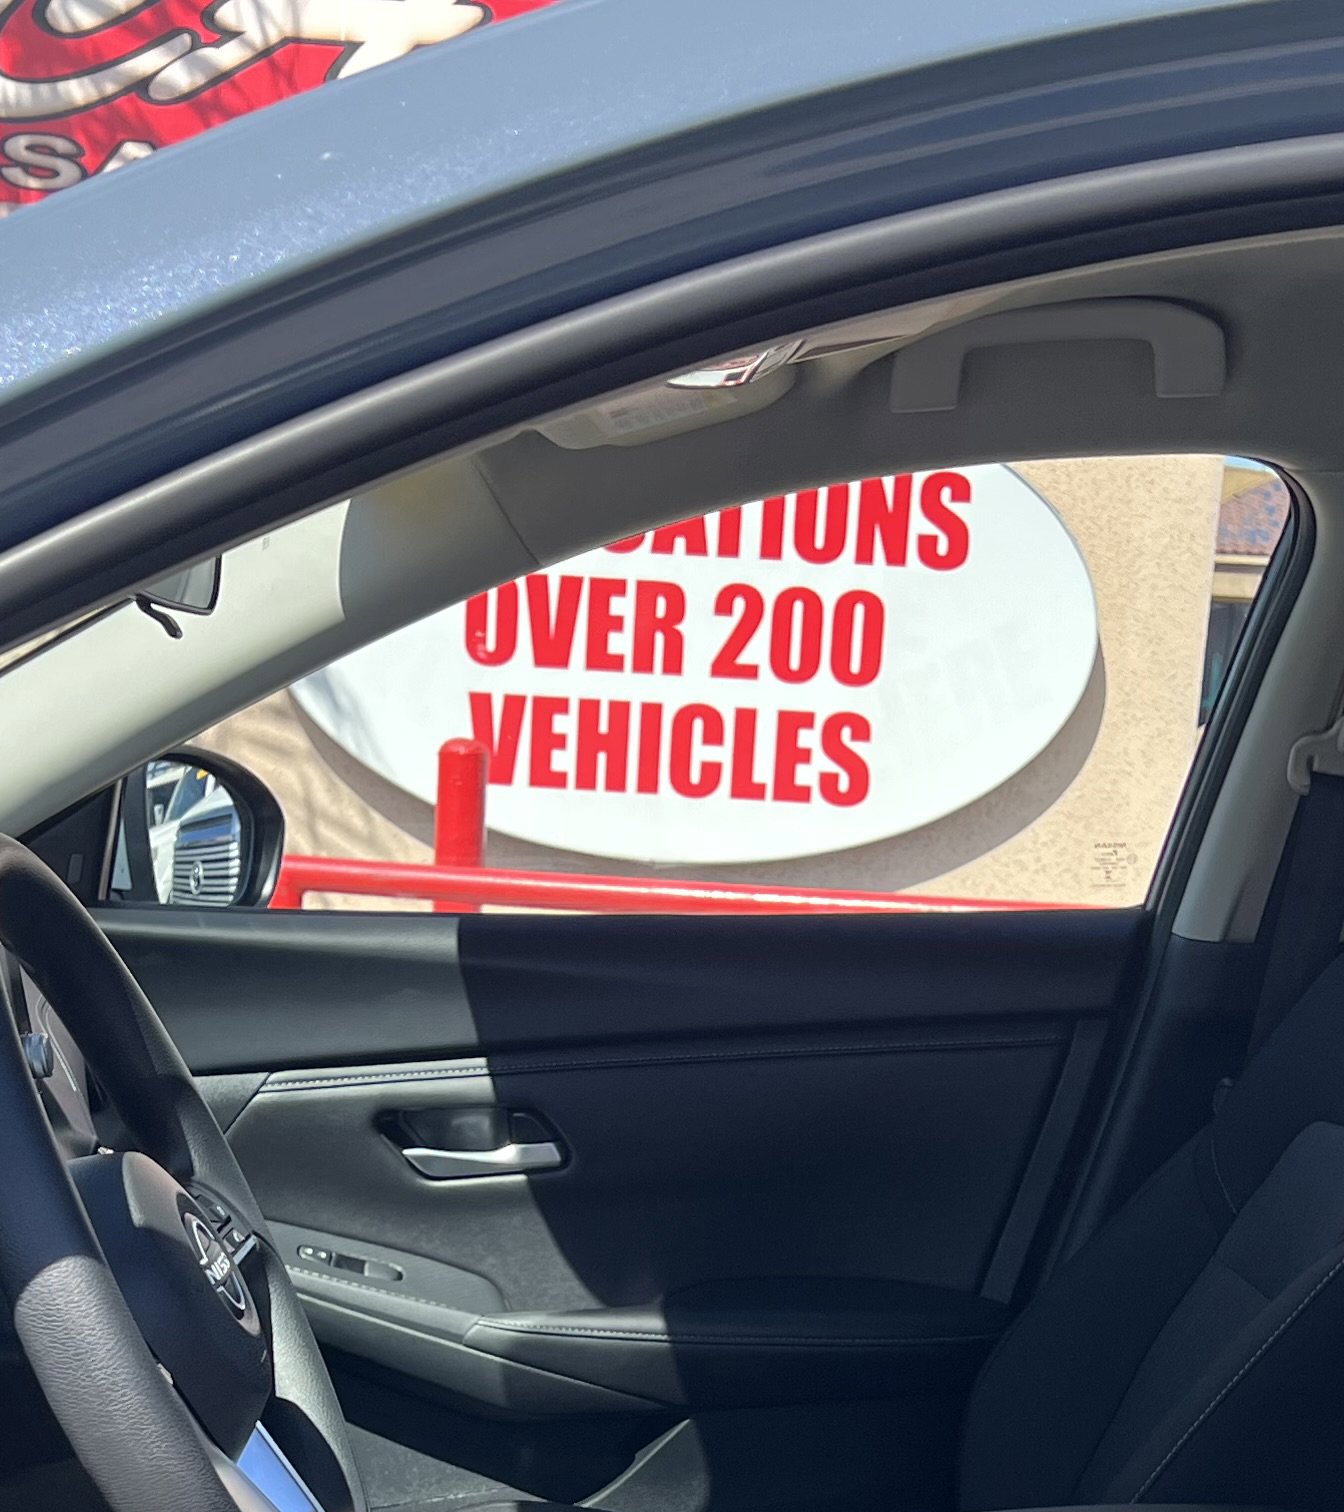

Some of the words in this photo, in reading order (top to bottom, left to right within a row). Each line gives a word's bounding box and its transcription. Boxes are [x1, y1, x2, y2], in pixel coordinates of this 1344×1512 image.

[464, 573, 686, 677] OVER
[709, 583, 885, 688] 200
[468, 690, 873, 808] VEHICLES
